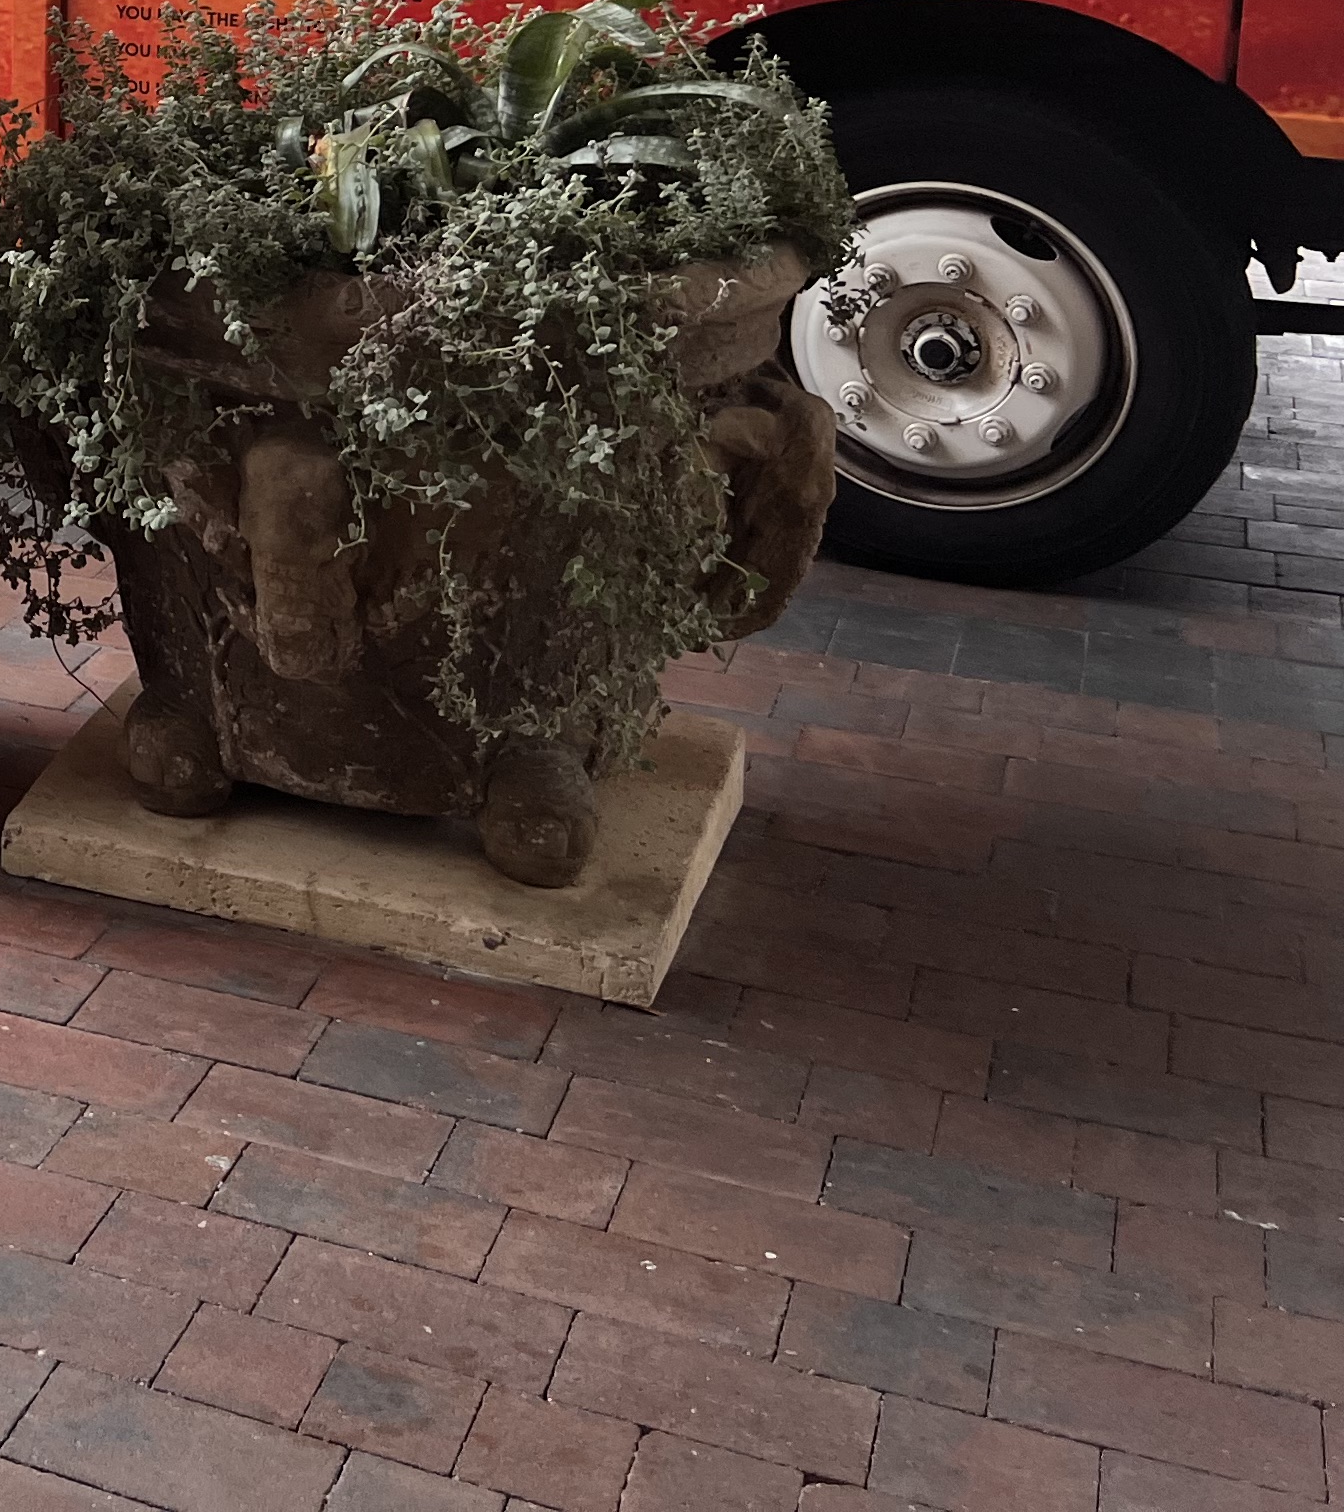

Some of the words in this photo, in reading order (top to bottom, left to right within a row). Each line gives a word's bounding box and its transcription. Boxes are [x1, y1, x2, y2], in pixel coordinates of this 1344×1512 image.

[116, 5, 152, 20] YOU
[207, 12, 239, 27] THE
[127, 79, 150, 95] OU
